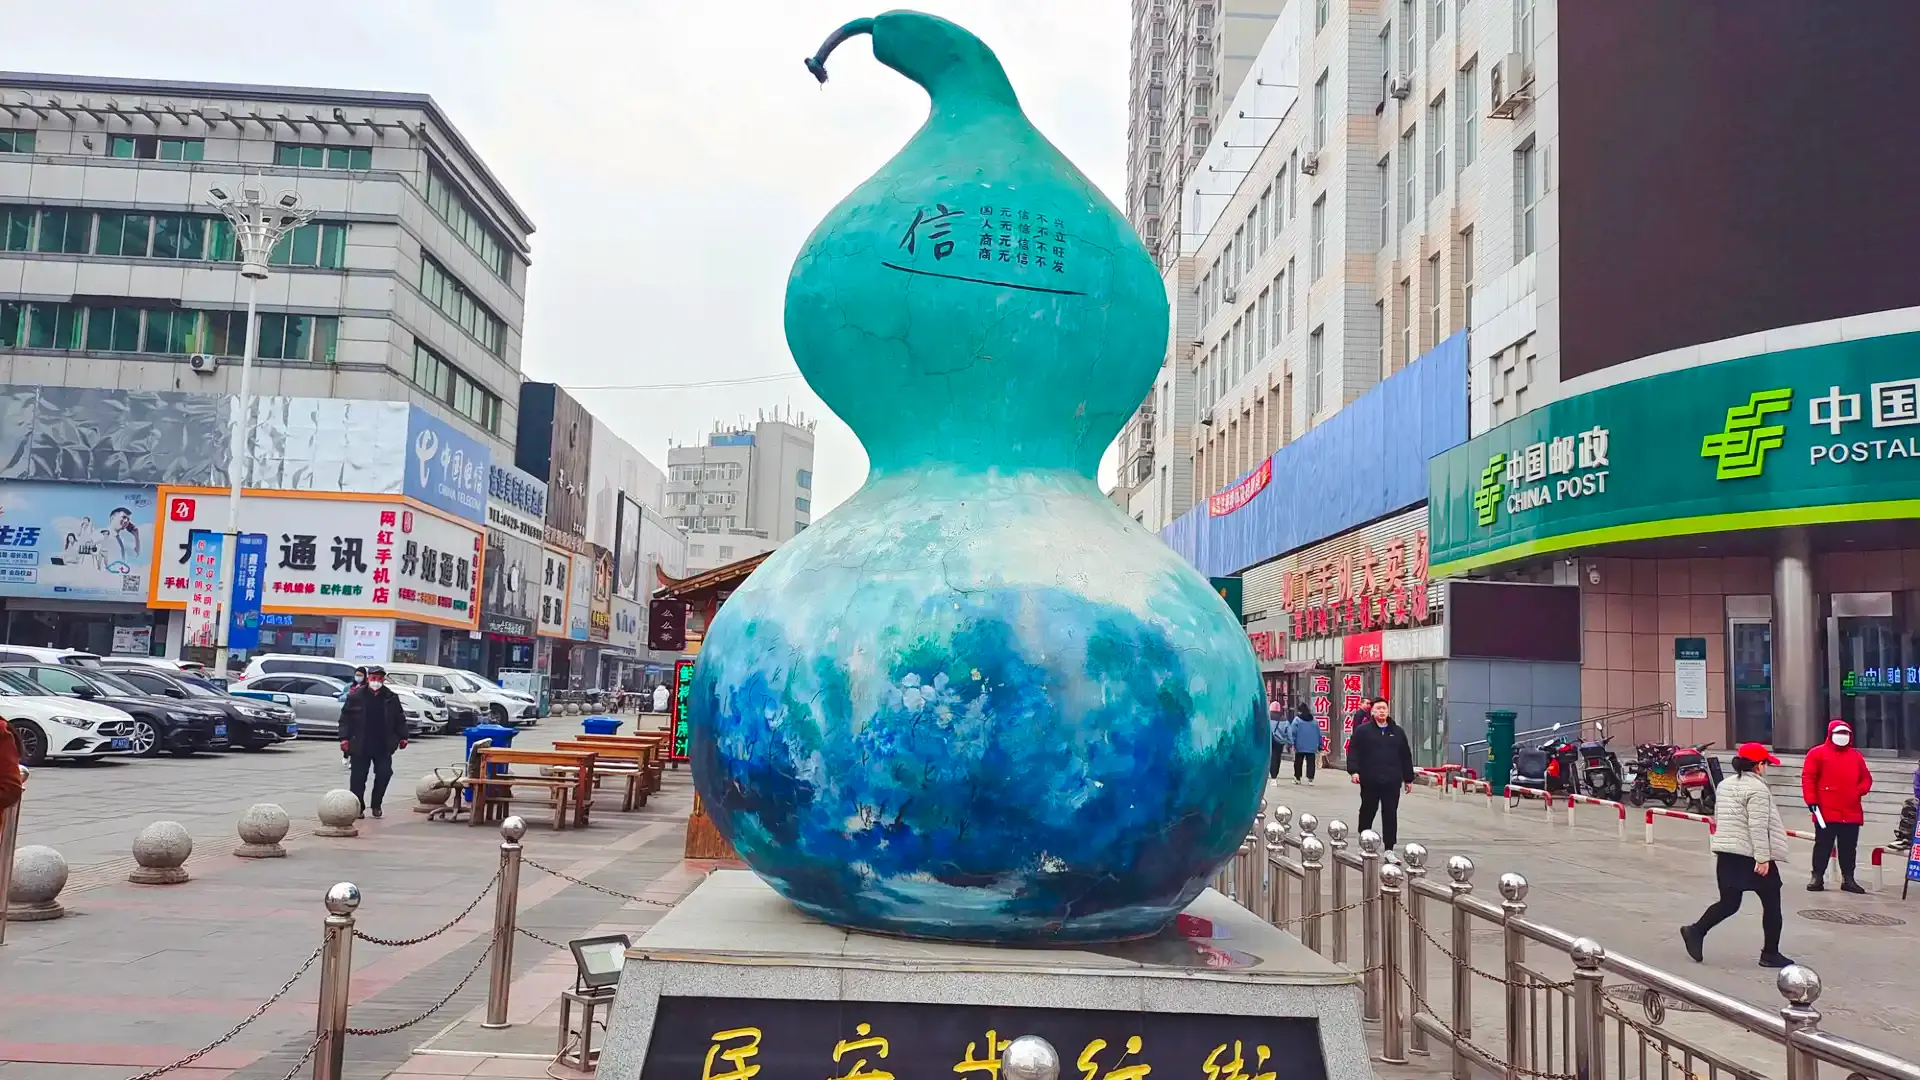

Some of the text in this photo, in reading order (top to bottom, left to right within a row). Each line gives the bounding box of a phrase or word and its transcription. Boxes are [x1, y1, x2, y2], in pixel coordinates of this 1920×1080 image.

[900, 203, 966, 261] 信
[1809, 377, 1920, 435] 中国
[440, 440, 484, 494] 中国电信
[1506, 425, 1609, 489] 中国邮政
[1810, 436, 1920, 466] POSTAL
[1506, 470, 1609, 514] CHINA POST
[164, 576, 190, 592] 手机
[371, 510, 397, 604] 网红手机店
[401, 539, 469, 591] 丹姐通讯
[1281, 529, 1430, 613] 地下手机大卖场
[320, 583, 363, 596] 配件超市
